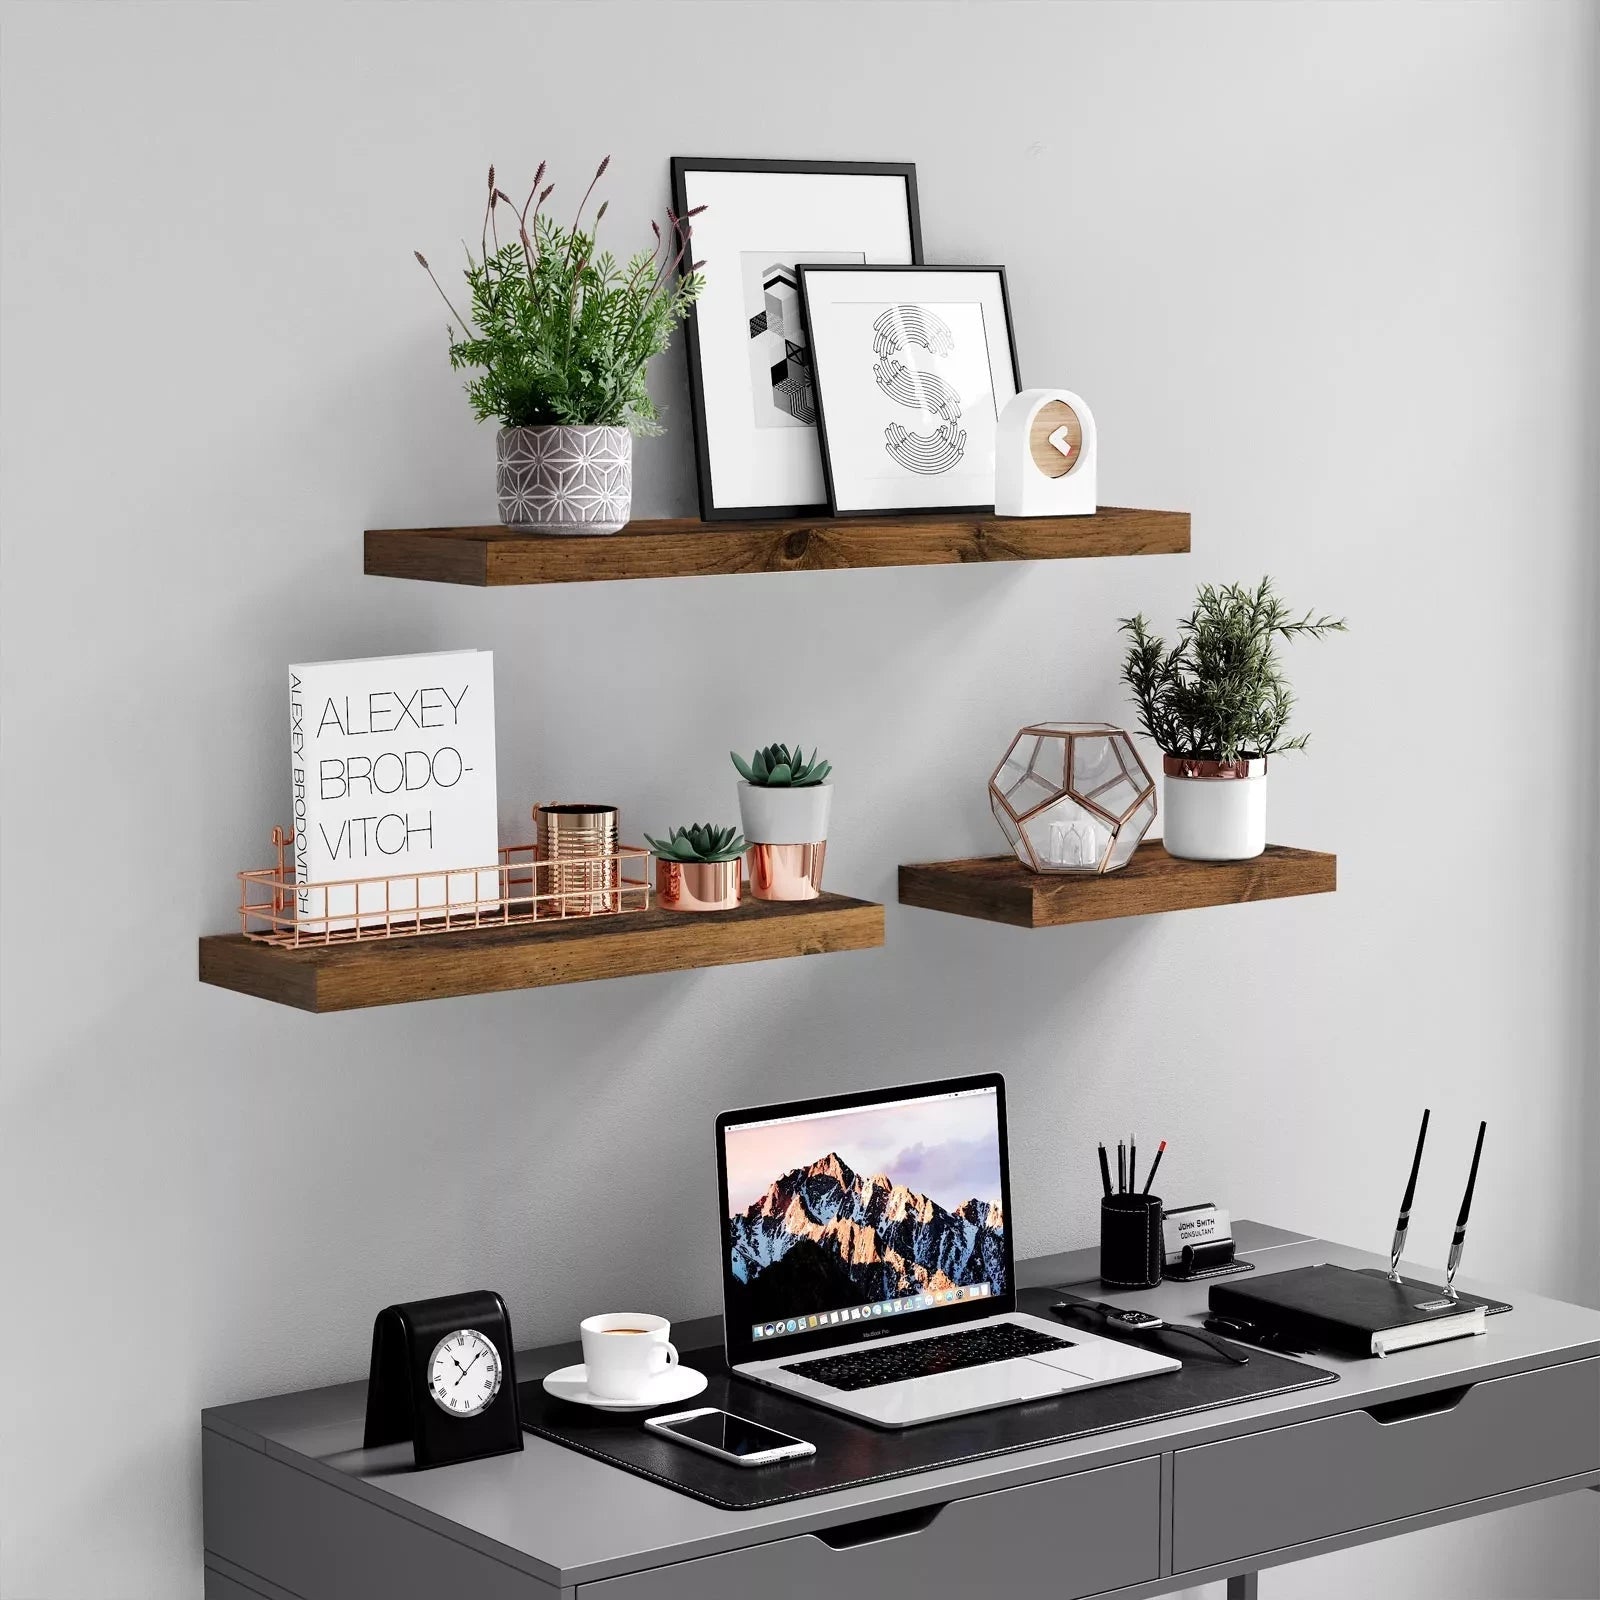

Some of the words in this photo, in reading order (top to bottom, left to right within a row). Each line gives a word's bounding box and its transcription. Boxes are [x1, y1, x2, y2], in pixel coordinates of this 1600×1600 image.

[290, 673, 304, 761] ALEXEY
[317, 685, 469, 738] ALEXEY
[320, 746, 473, 800] BRODO-
[294, 769, 309, 914] BRODOVITCH
[319, 810, 433, 860] VITCH
